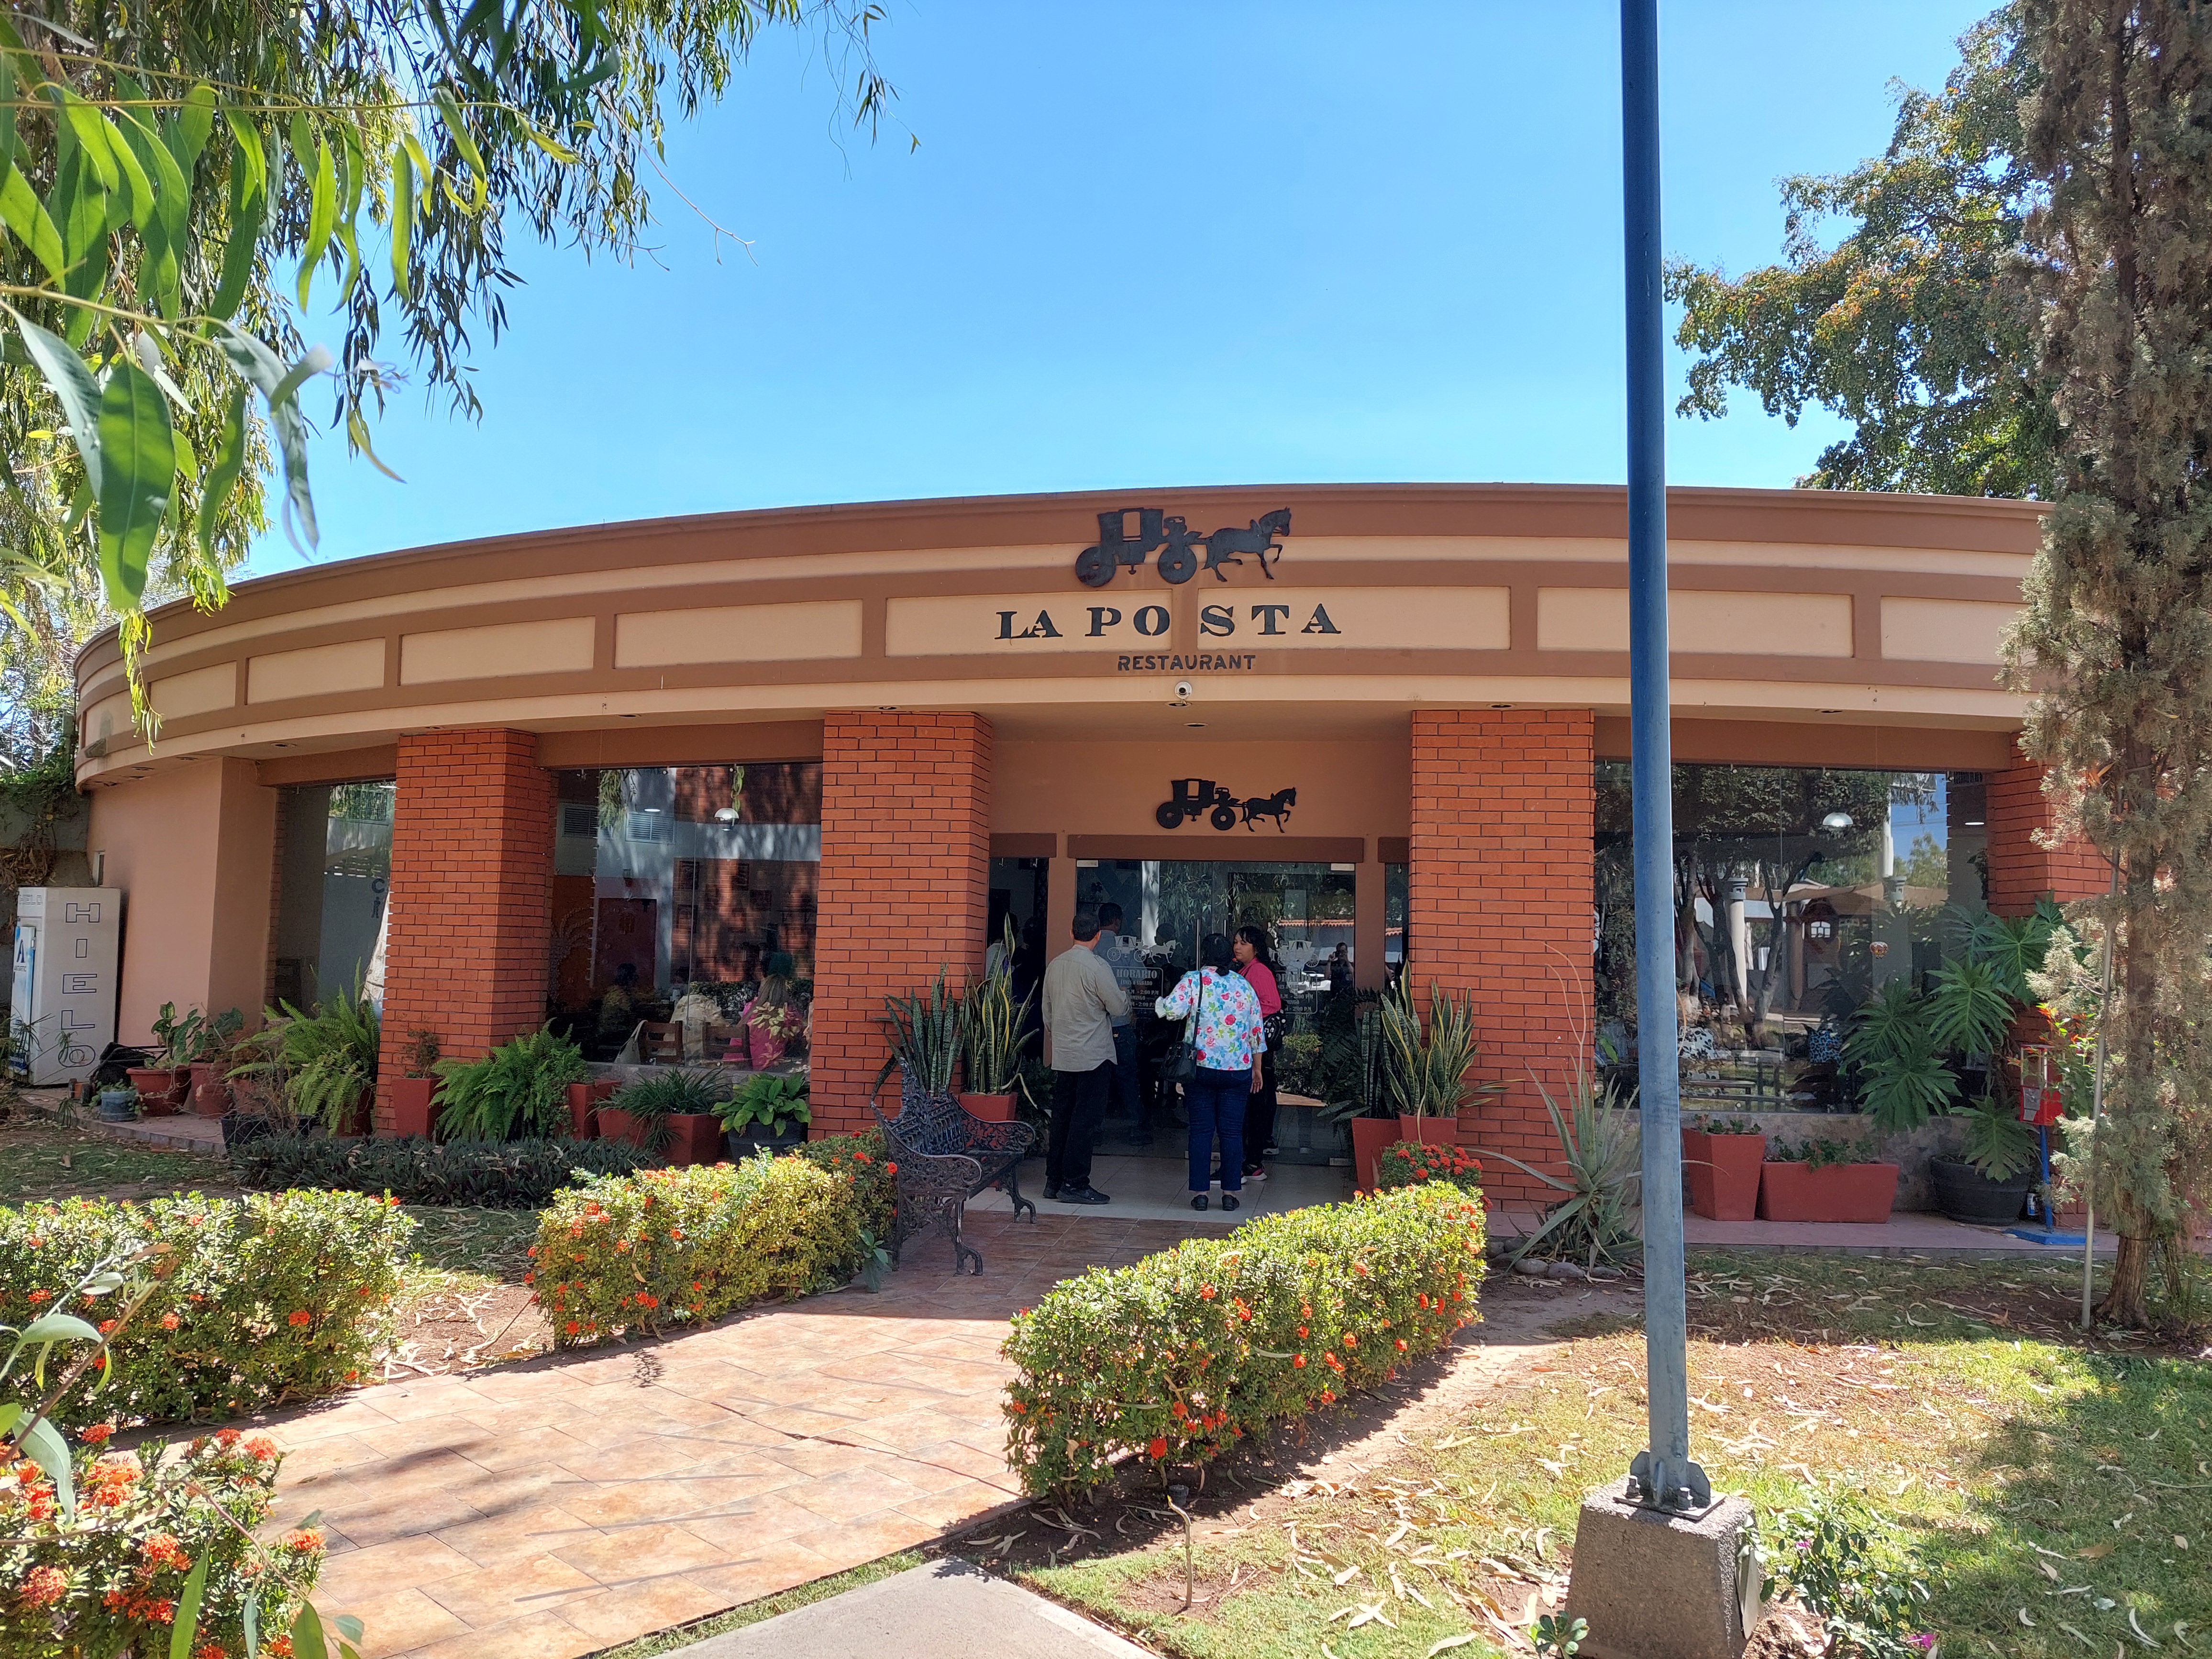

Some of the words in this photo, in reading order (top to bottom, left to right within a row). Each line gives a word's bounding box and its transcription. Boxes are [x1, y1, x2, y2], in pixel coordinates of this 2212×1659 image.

[994, 610, 1063, 640] LA
[1084, 603, 1342, 637] POSTA
[1117, 654, 1256, 671] RESTAURANT
[58, 903, 101, 1068] HIELO
